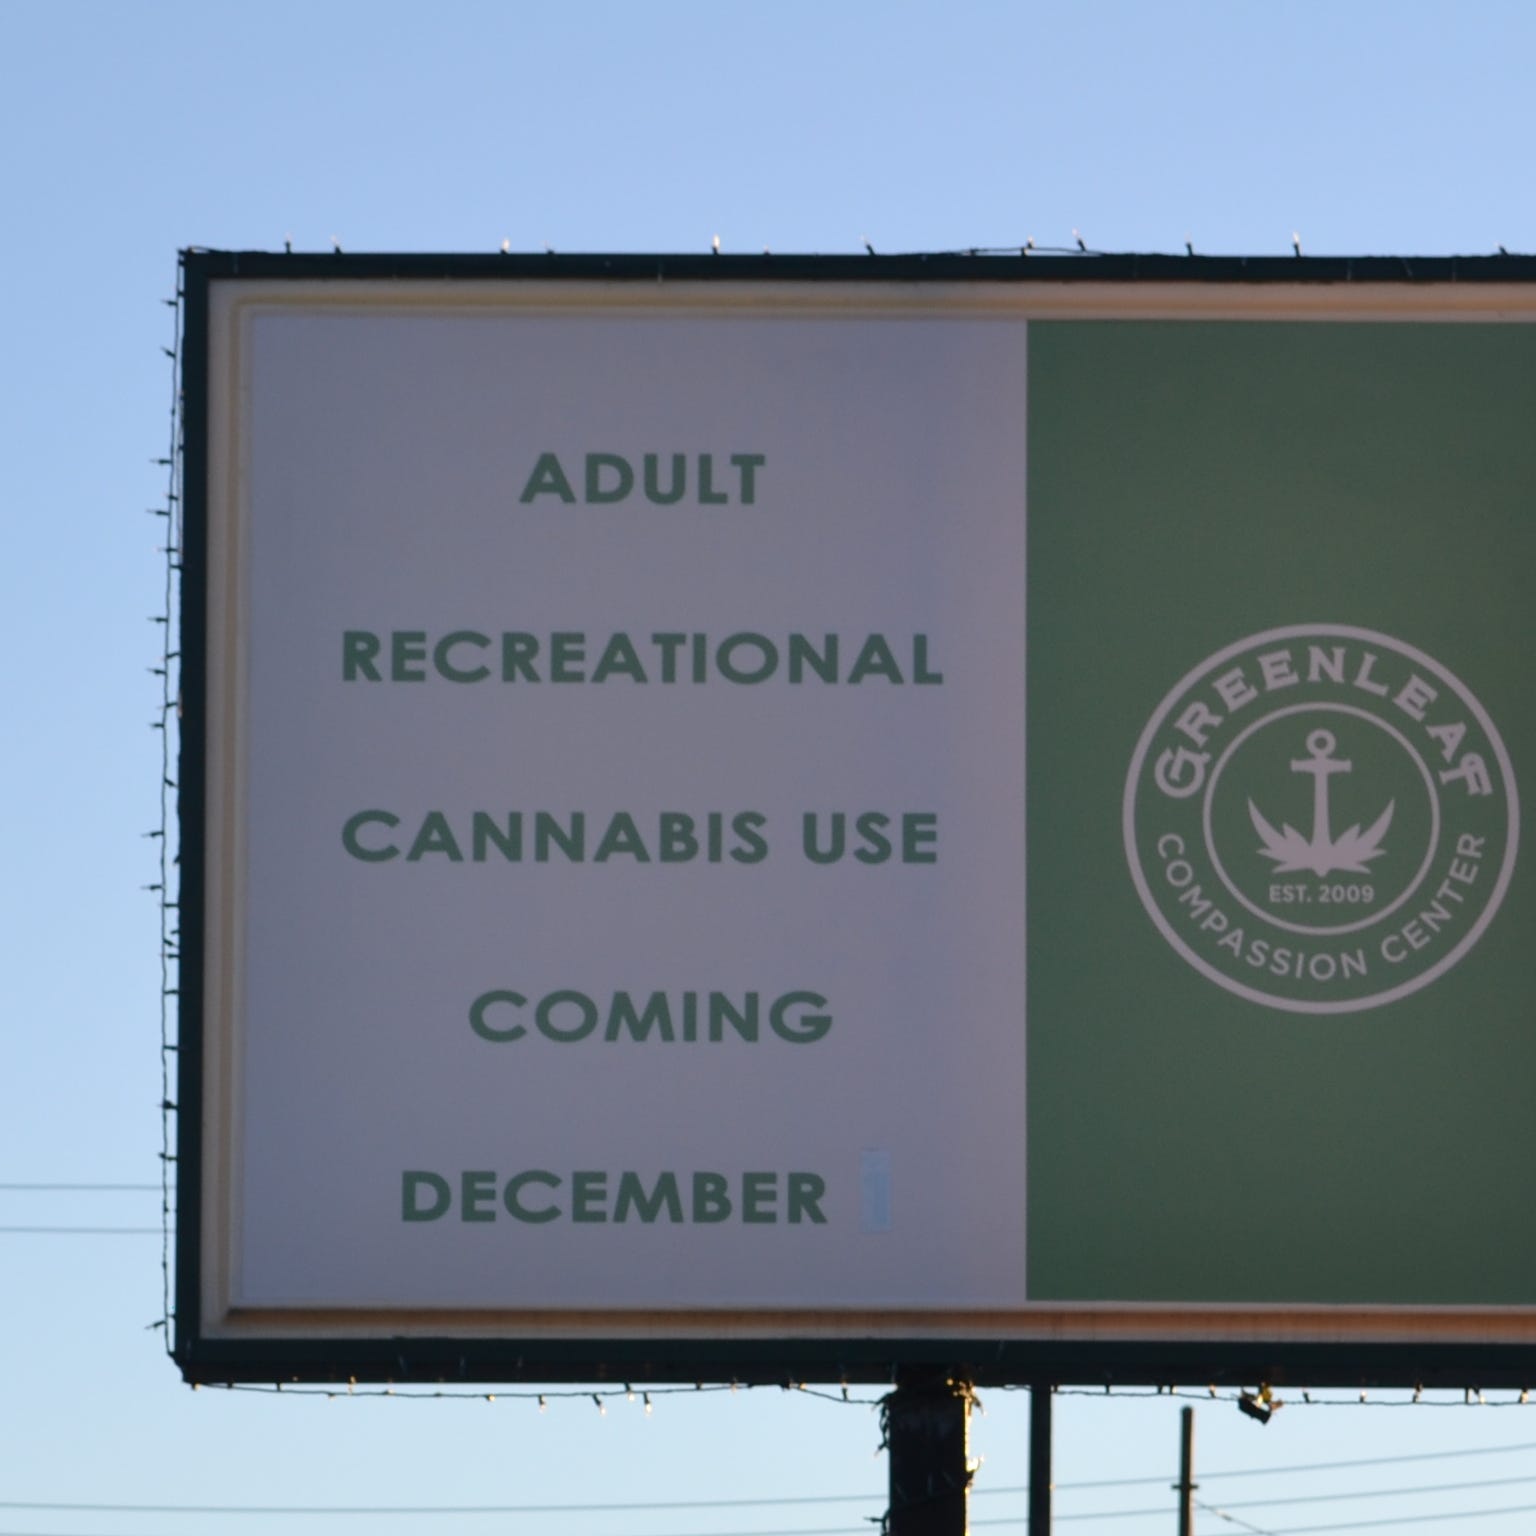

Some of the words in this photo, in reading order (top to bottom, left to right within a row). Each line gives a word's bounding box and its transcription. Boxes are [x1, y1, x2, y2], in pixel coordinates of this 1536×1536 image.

[518, 451, 767, 506] ADULT
[341, 629, 945, 686] RECREATIONAL
[1154, 645, 1494, 799] GREENLEAF
[340, 808, 770, 865] CANNABIS
[801, 810, 938, 866] USE
[1157, 832, 1369, 982] COMPASSION
[1379, 831, 1486, 963] CENTER
[1268, 884, 1313, 903] EST.
[1317, 884, 1375, 903] 2009
[467, 988, 834, 1045] COMING
[400, 1168, 829, 1226] DECEMBER
